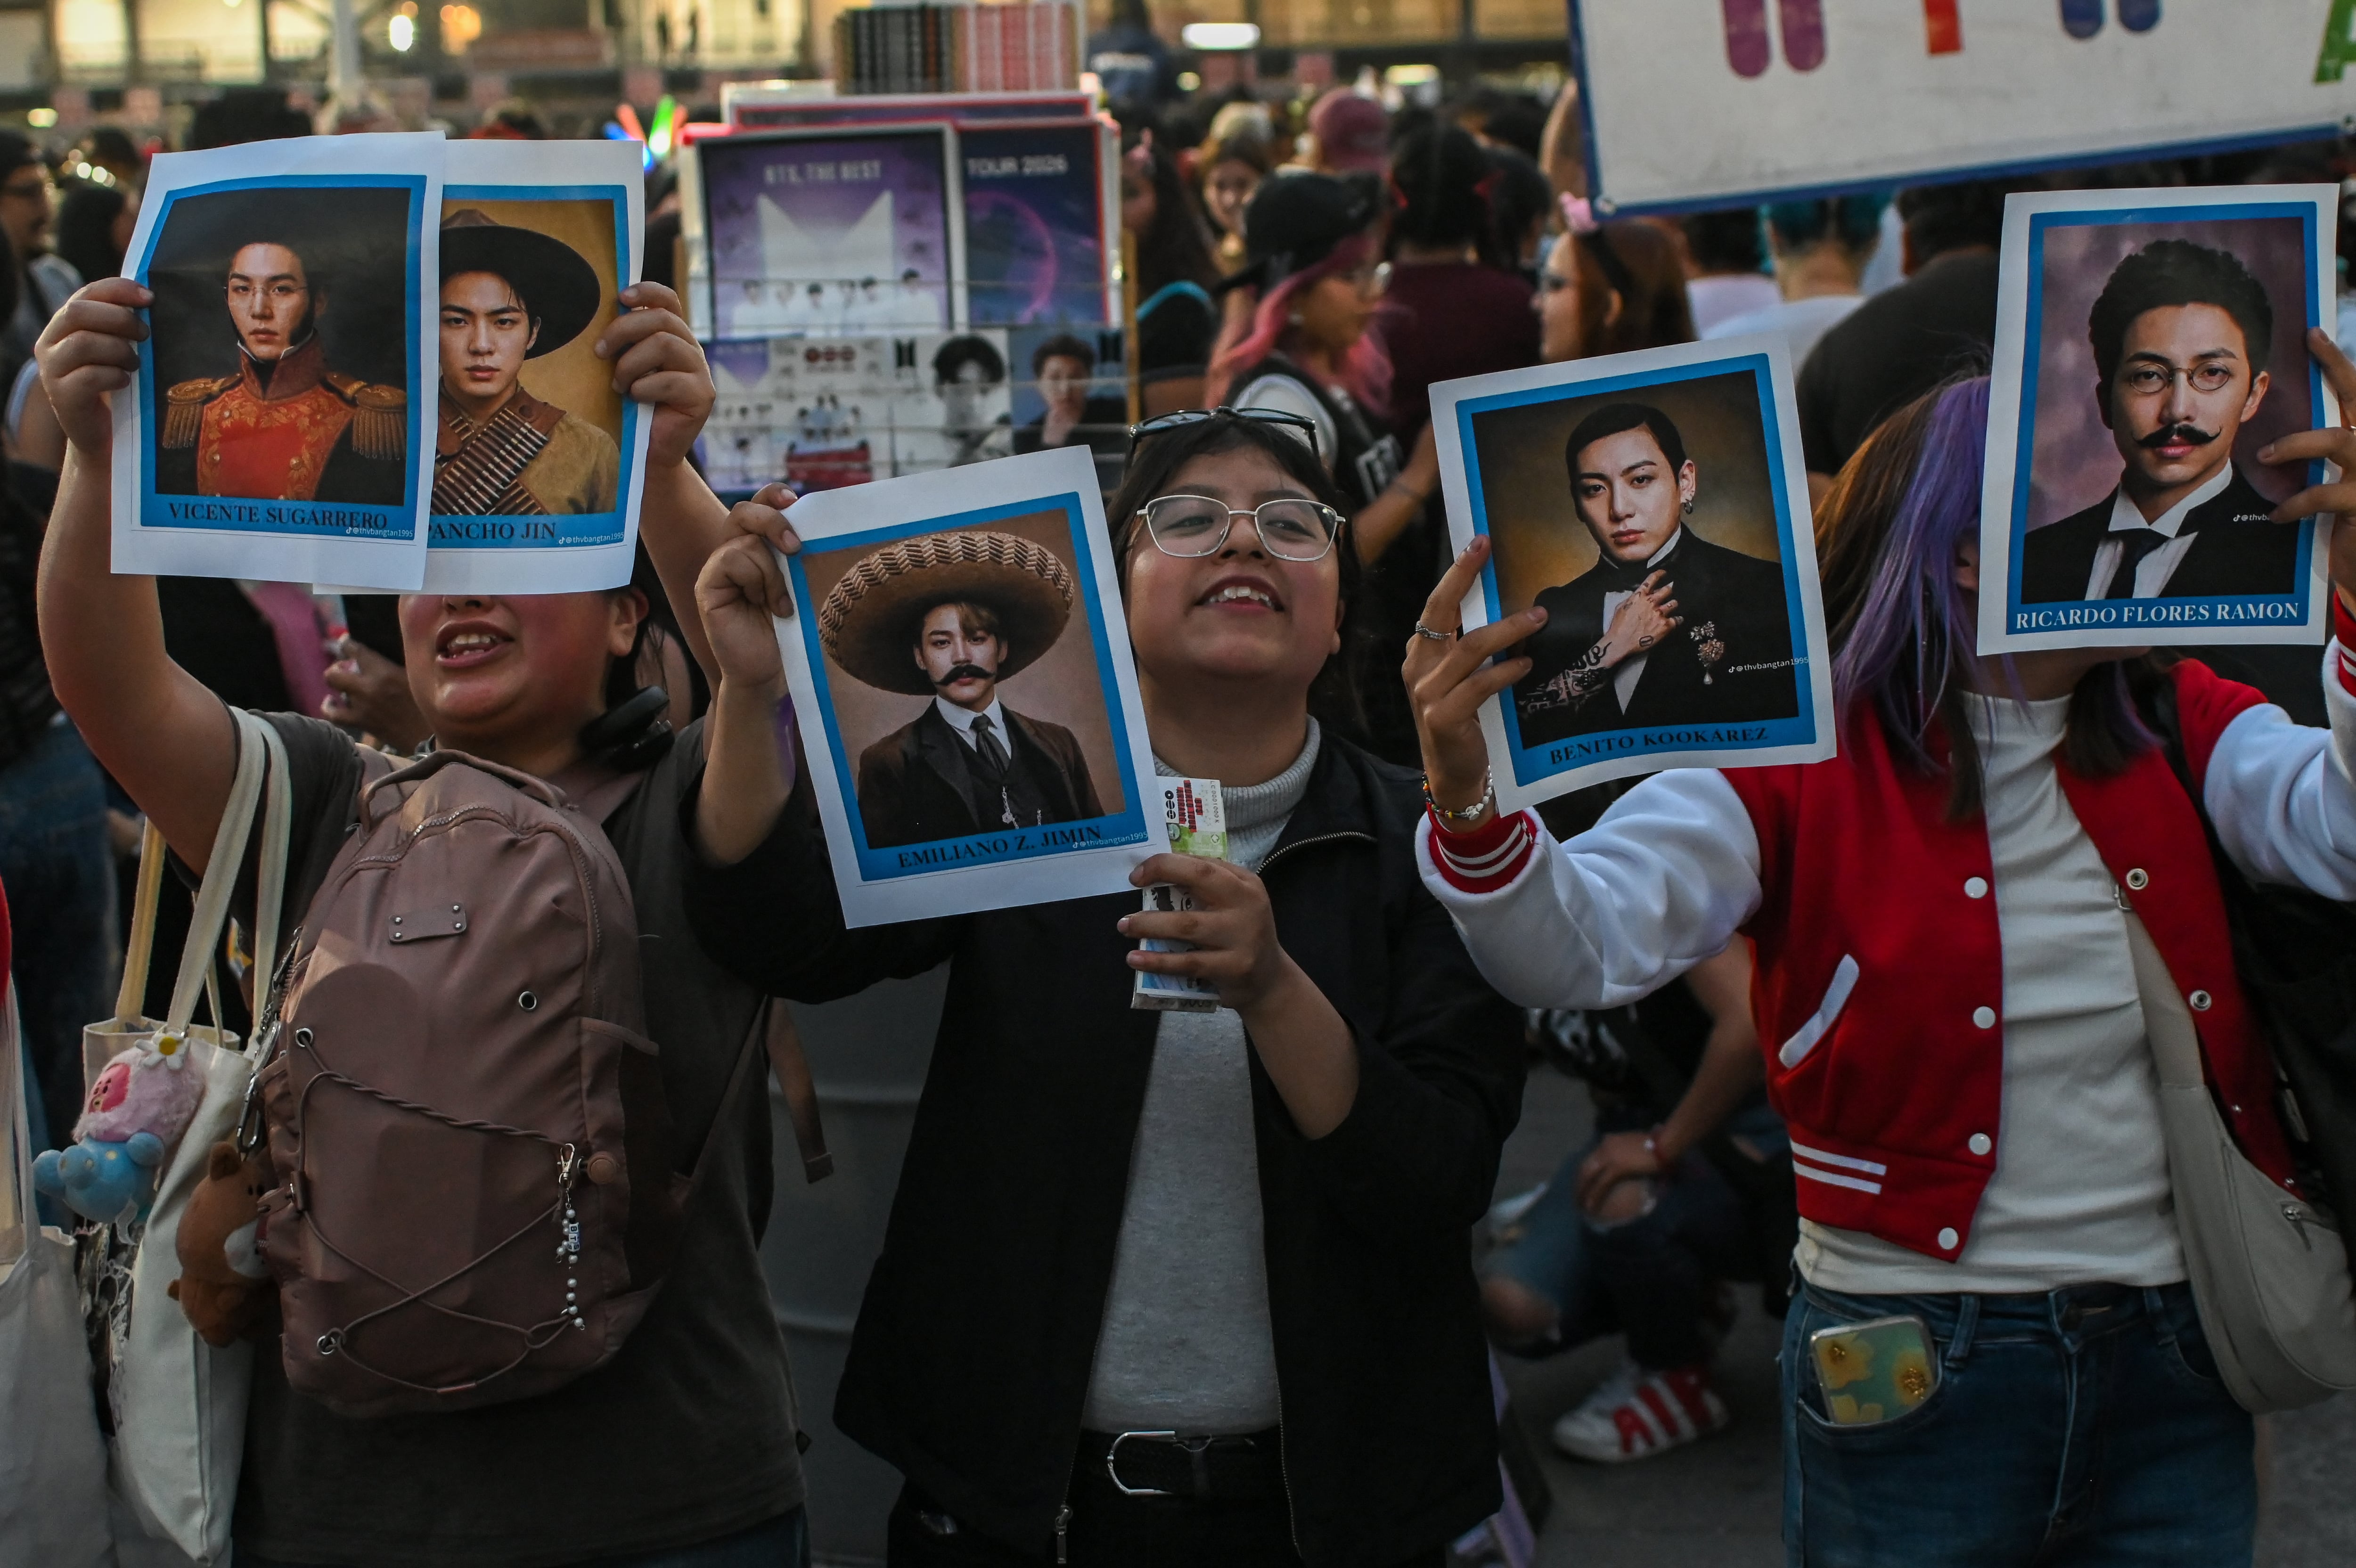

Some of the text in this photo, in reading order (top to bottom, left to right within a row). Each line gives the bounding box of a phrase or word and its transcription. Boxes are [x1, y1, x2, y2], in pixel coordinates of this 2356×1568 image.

[168, 502, 388, 529] VICENTE SUGARRERO
[353, 527, 413, 538] @thvbangtan1995
[521, 522, 556, 539] JIN
[565, 531, 624, 544] @thvbangtan1995
[2016, 602, 2299, 629] RICARDO FLORES RAMON
[1736, 656, 1809, 672] @thvbangtan1995
[1550, 735, 1635, 765] BENITO
[897, 825, 1102, 868] EMILIANO Z. JIMIN
[1079, 832, 1148, 847] @thvbangtan1995
